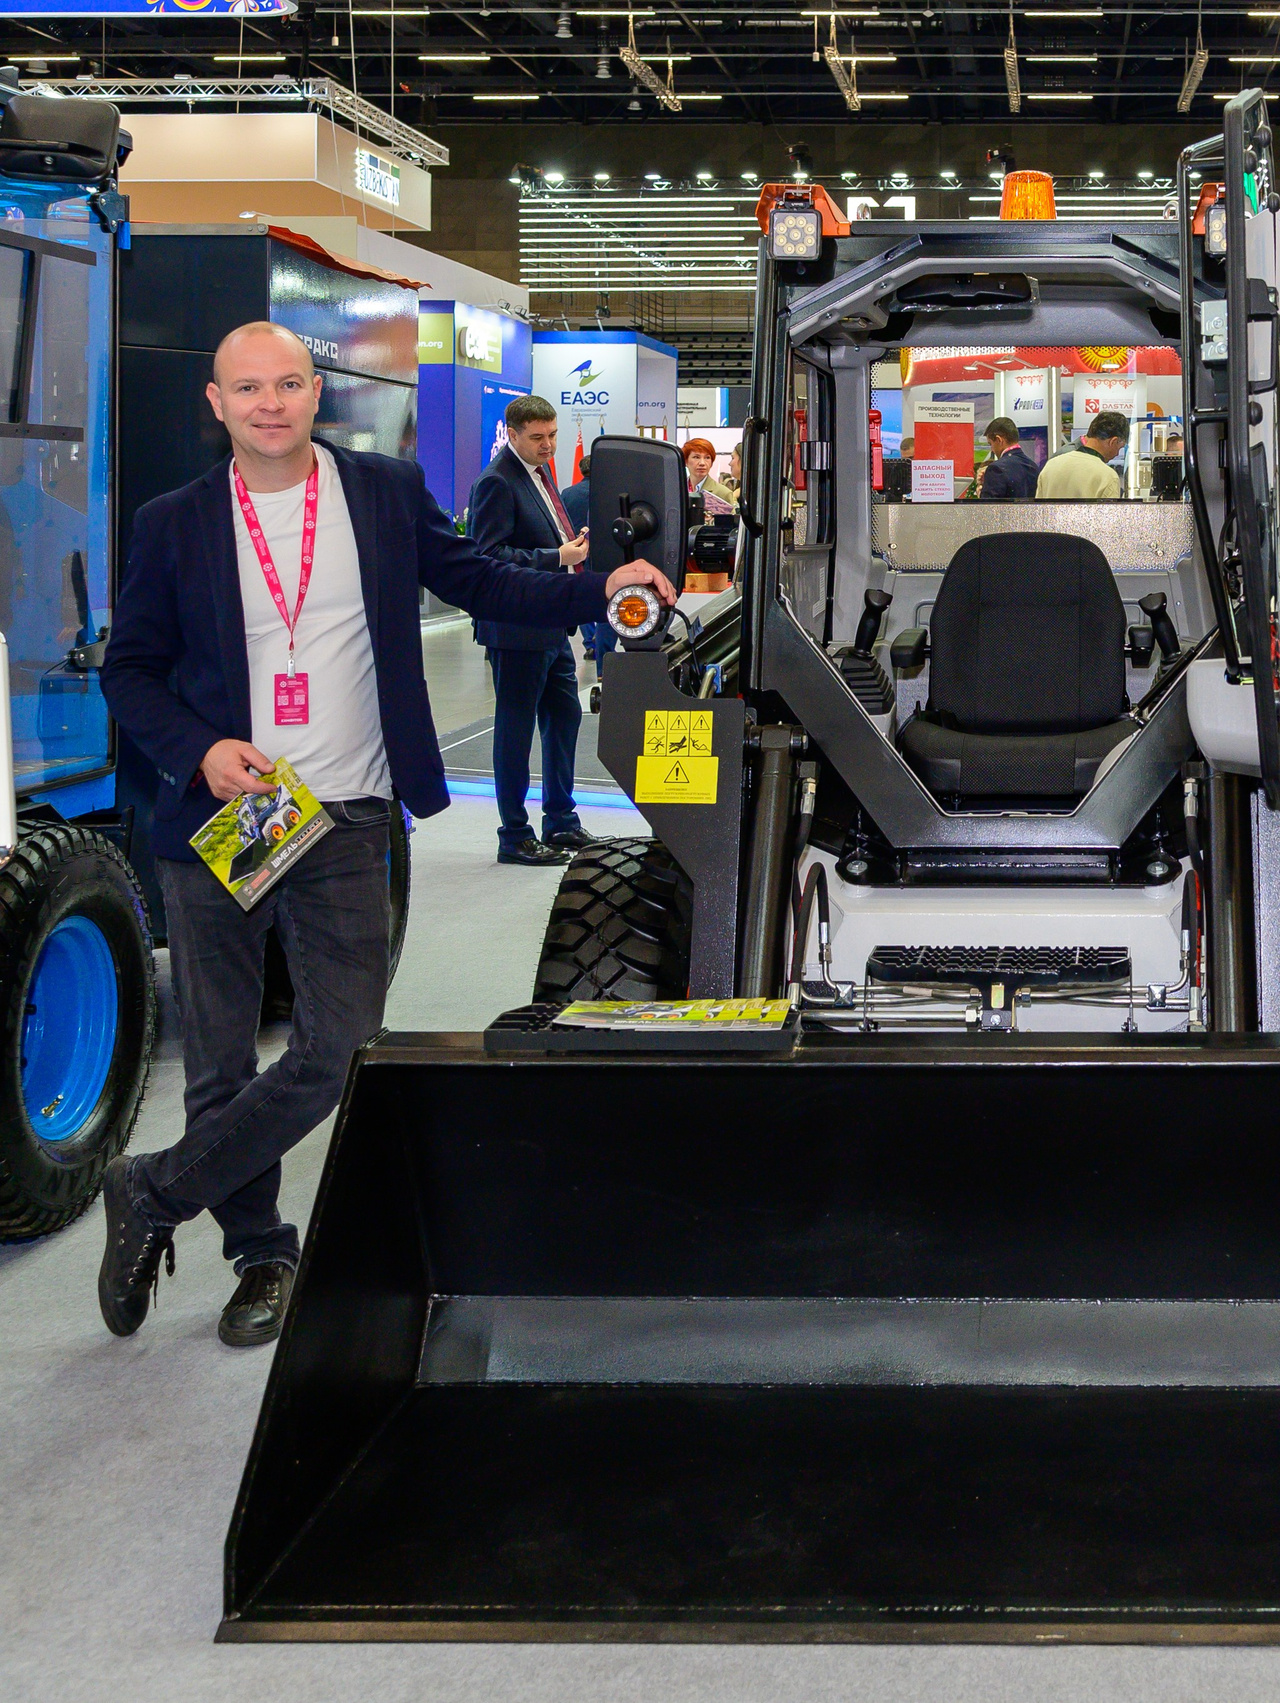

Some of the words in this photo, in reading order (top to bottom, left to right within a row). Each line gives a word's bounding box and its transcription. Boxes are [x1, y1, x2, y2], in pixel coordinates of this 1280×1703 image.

[295, 333, 338, 360] РАКС
[561, 391, 609, 405] ЕАЭС
[271, 842, 299, 869] ШМЕЛЬ
